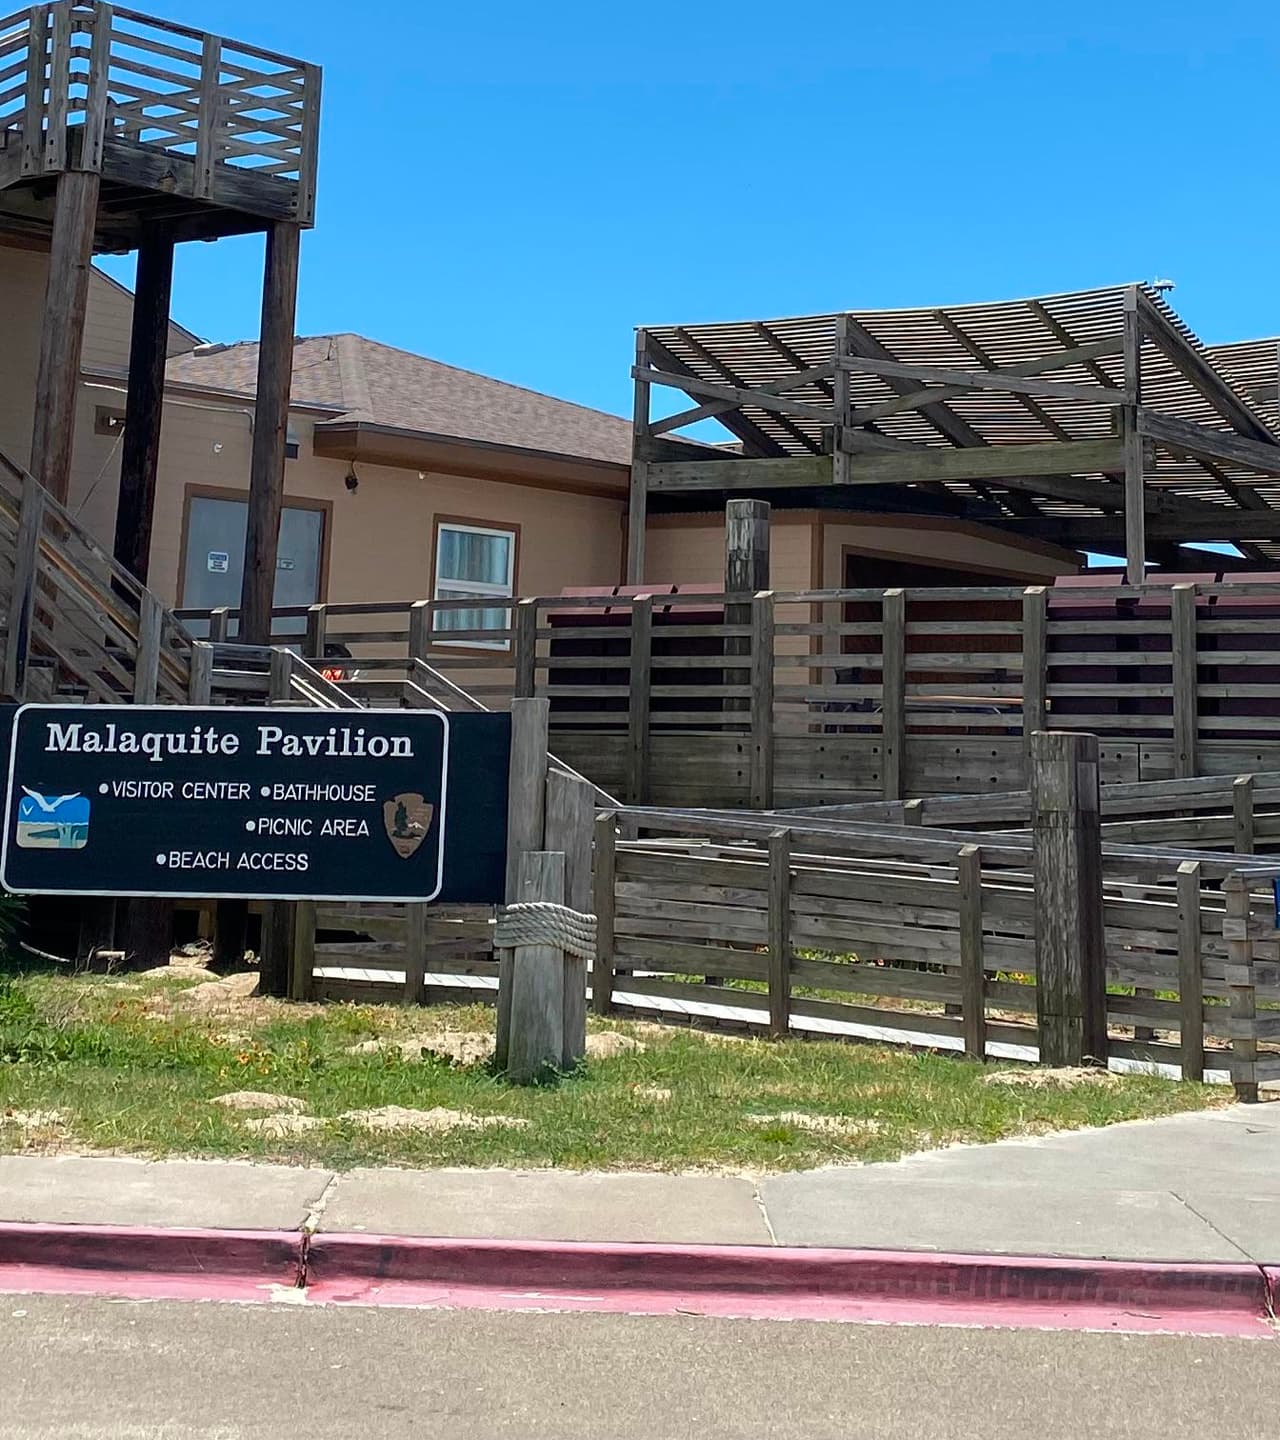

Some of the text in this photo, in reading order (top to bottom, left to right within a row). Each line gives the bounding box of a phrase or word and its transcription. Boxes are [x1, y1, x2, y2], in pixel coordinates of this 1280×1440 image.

[44, 722, 415, 762] Malaquite Pavilion
[112, 780, 251, 800] VISITOR CENTER
[273, 783, 377, 802] BATHHOUSE
[258, 817, 370, 837] PICNIC AREA
[168, 851, 309, 871] BEACH ACCESS
